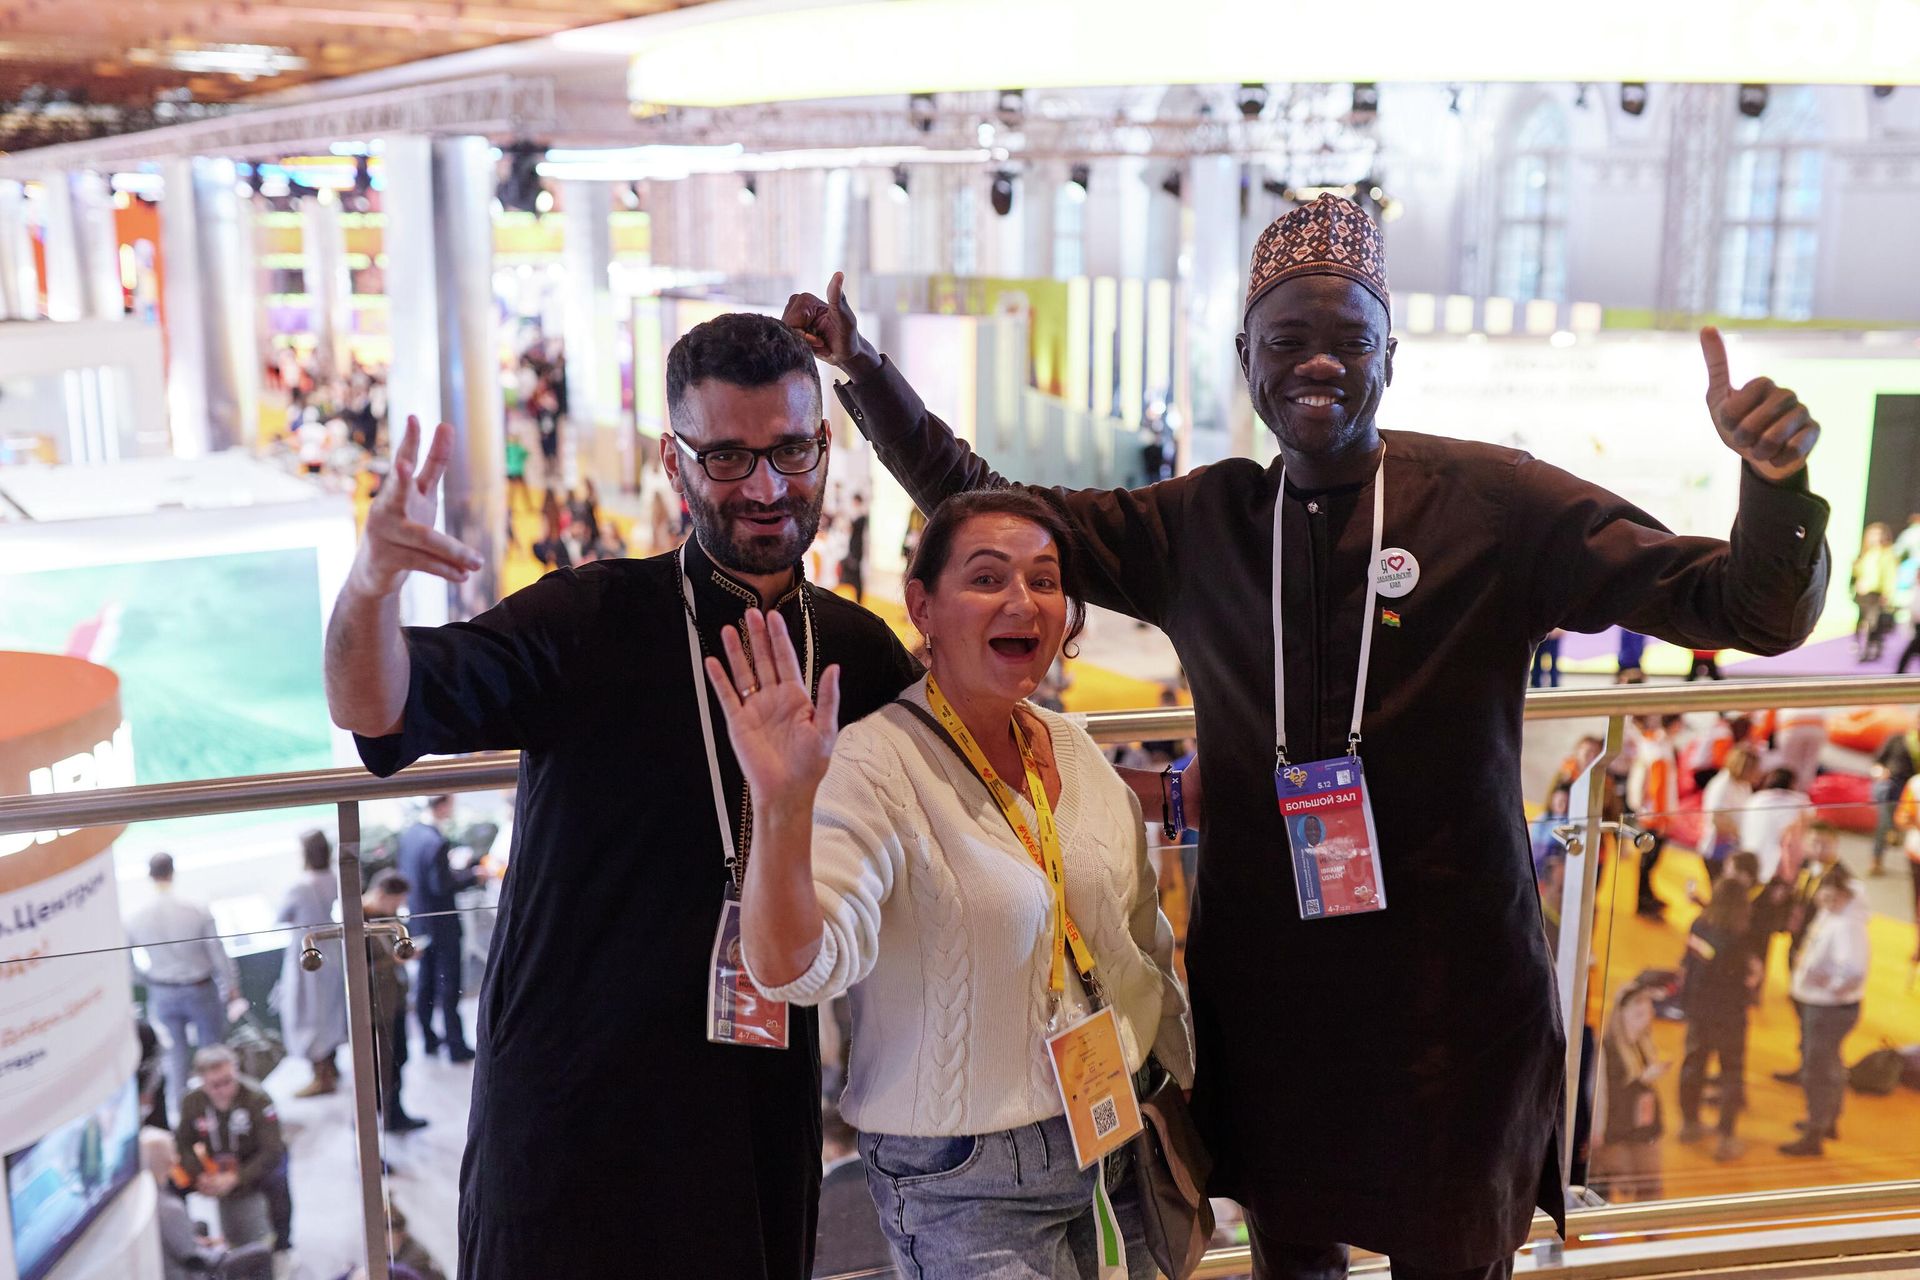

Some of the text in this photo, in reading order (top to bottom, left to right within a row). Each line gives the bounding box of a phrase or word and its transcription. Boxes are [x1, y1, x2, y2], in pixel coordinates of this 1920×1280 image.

[1317, 780, 1332, 789] 5.12
[1285, 792, 1357, 811] БОЛЬШОЙ ЗАЛ
